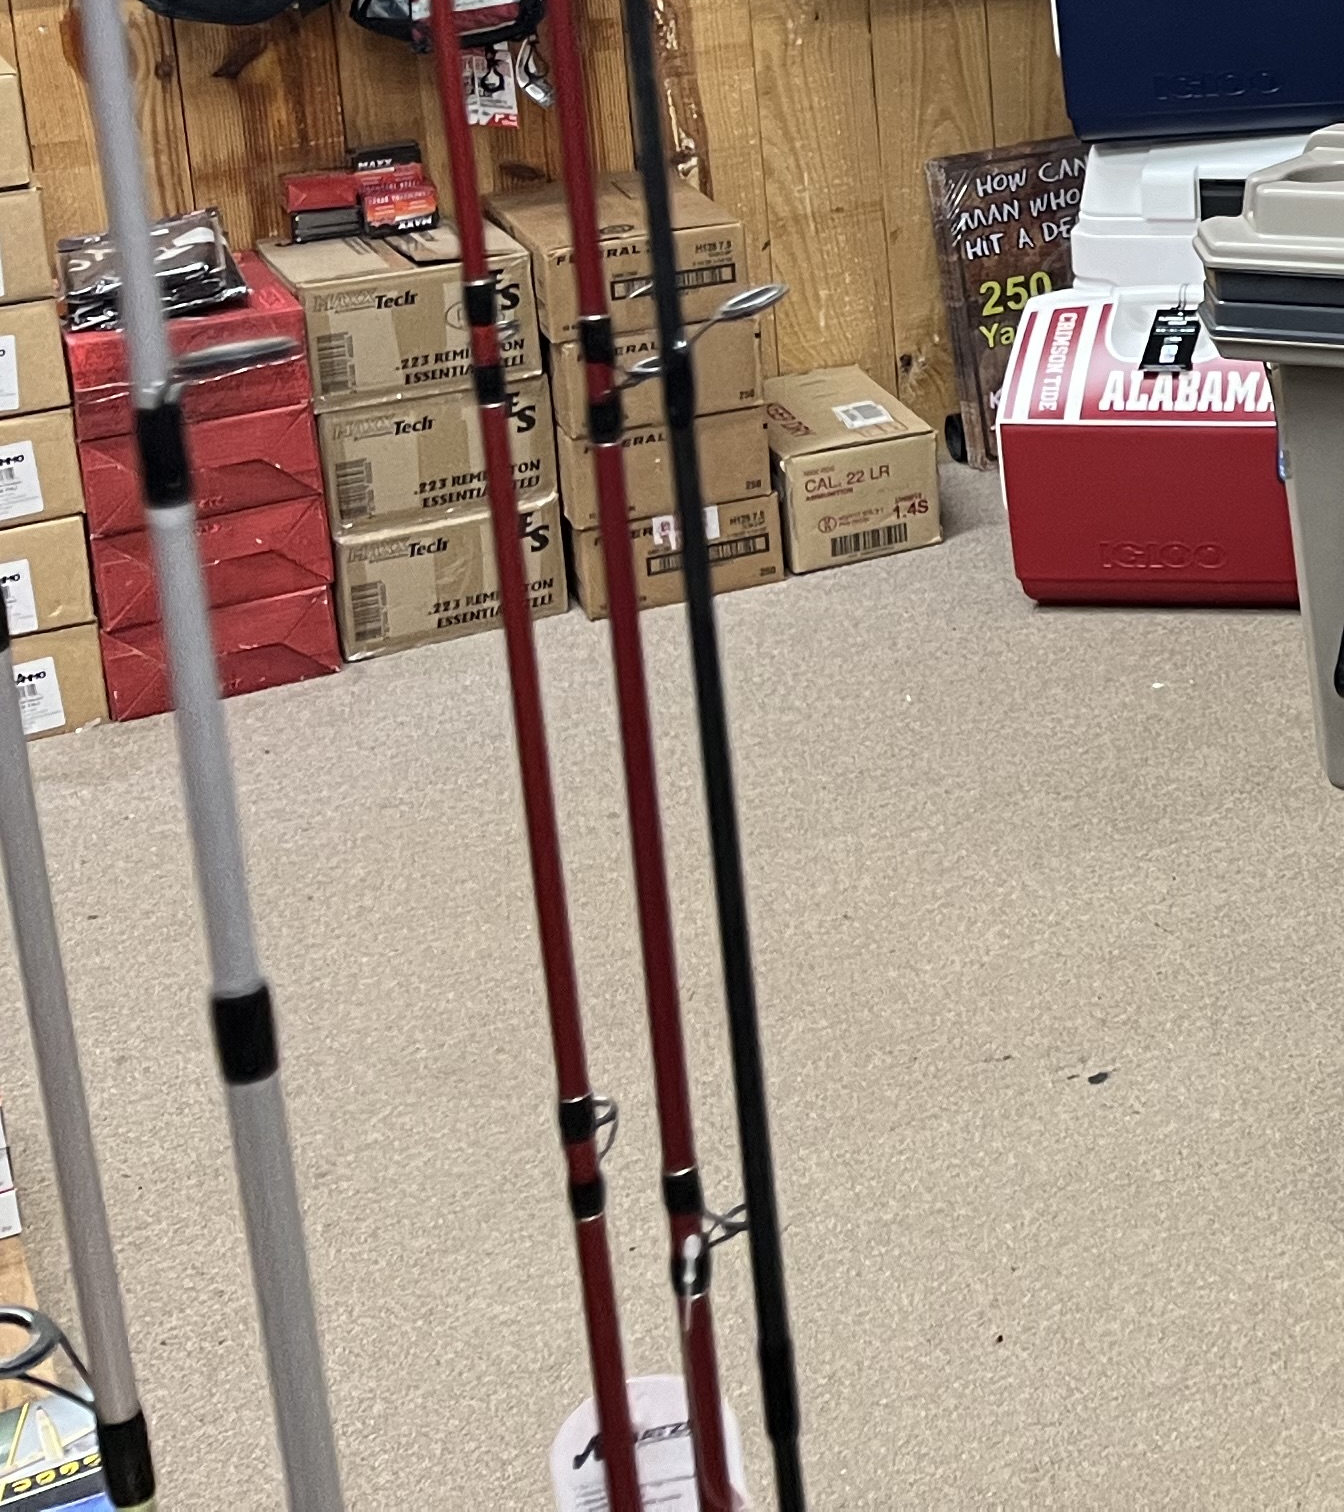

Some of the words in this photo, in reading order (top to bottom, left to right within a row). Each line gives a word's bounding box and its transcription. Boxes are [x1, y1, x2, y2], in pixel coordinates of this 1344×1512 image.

[357, 158, 392, 170] MAXX
[976, 167, 1028, 198] HOW
[1038, 155, 1088, 183] CAN
[959, 199, 1020, 232] MAN
[1030, 187, 1080, 218] WHO
[1018, 226, 1035, 249] A
[556, 244, 641, 266] FRAL
[375, 289, 419, 310] Tech
[979, 270, 1053, 317] 250
[395, 353, 431, 371] .223
[433, 338, 525, 365] REMION
[1044, 312, 1078, 375] CRIMSON
[404, 364, 474, 385] ESSENTIA
[1038, 375, 1063, 413] TIDE
[1098, 370, 1276, 413] ALABAMA
[393, 415, 434, 436] Tech
[451, 458, 542, 487] REMTON
[804, 476, 842, 494] CAL.
[846, 470, 866, 486] 22
[870, 464, 890, 481] LR
[422, 488, 488, 509] ESSENTIA
[892, 498, 930, 520] 1.4S
[407, 537, 450, 558] Tech
[1100, 541, 1228, 569] IGLOO
[465, 577, 554, 608] REMTON
[436, 607, 502, 629] ESSENTIA
